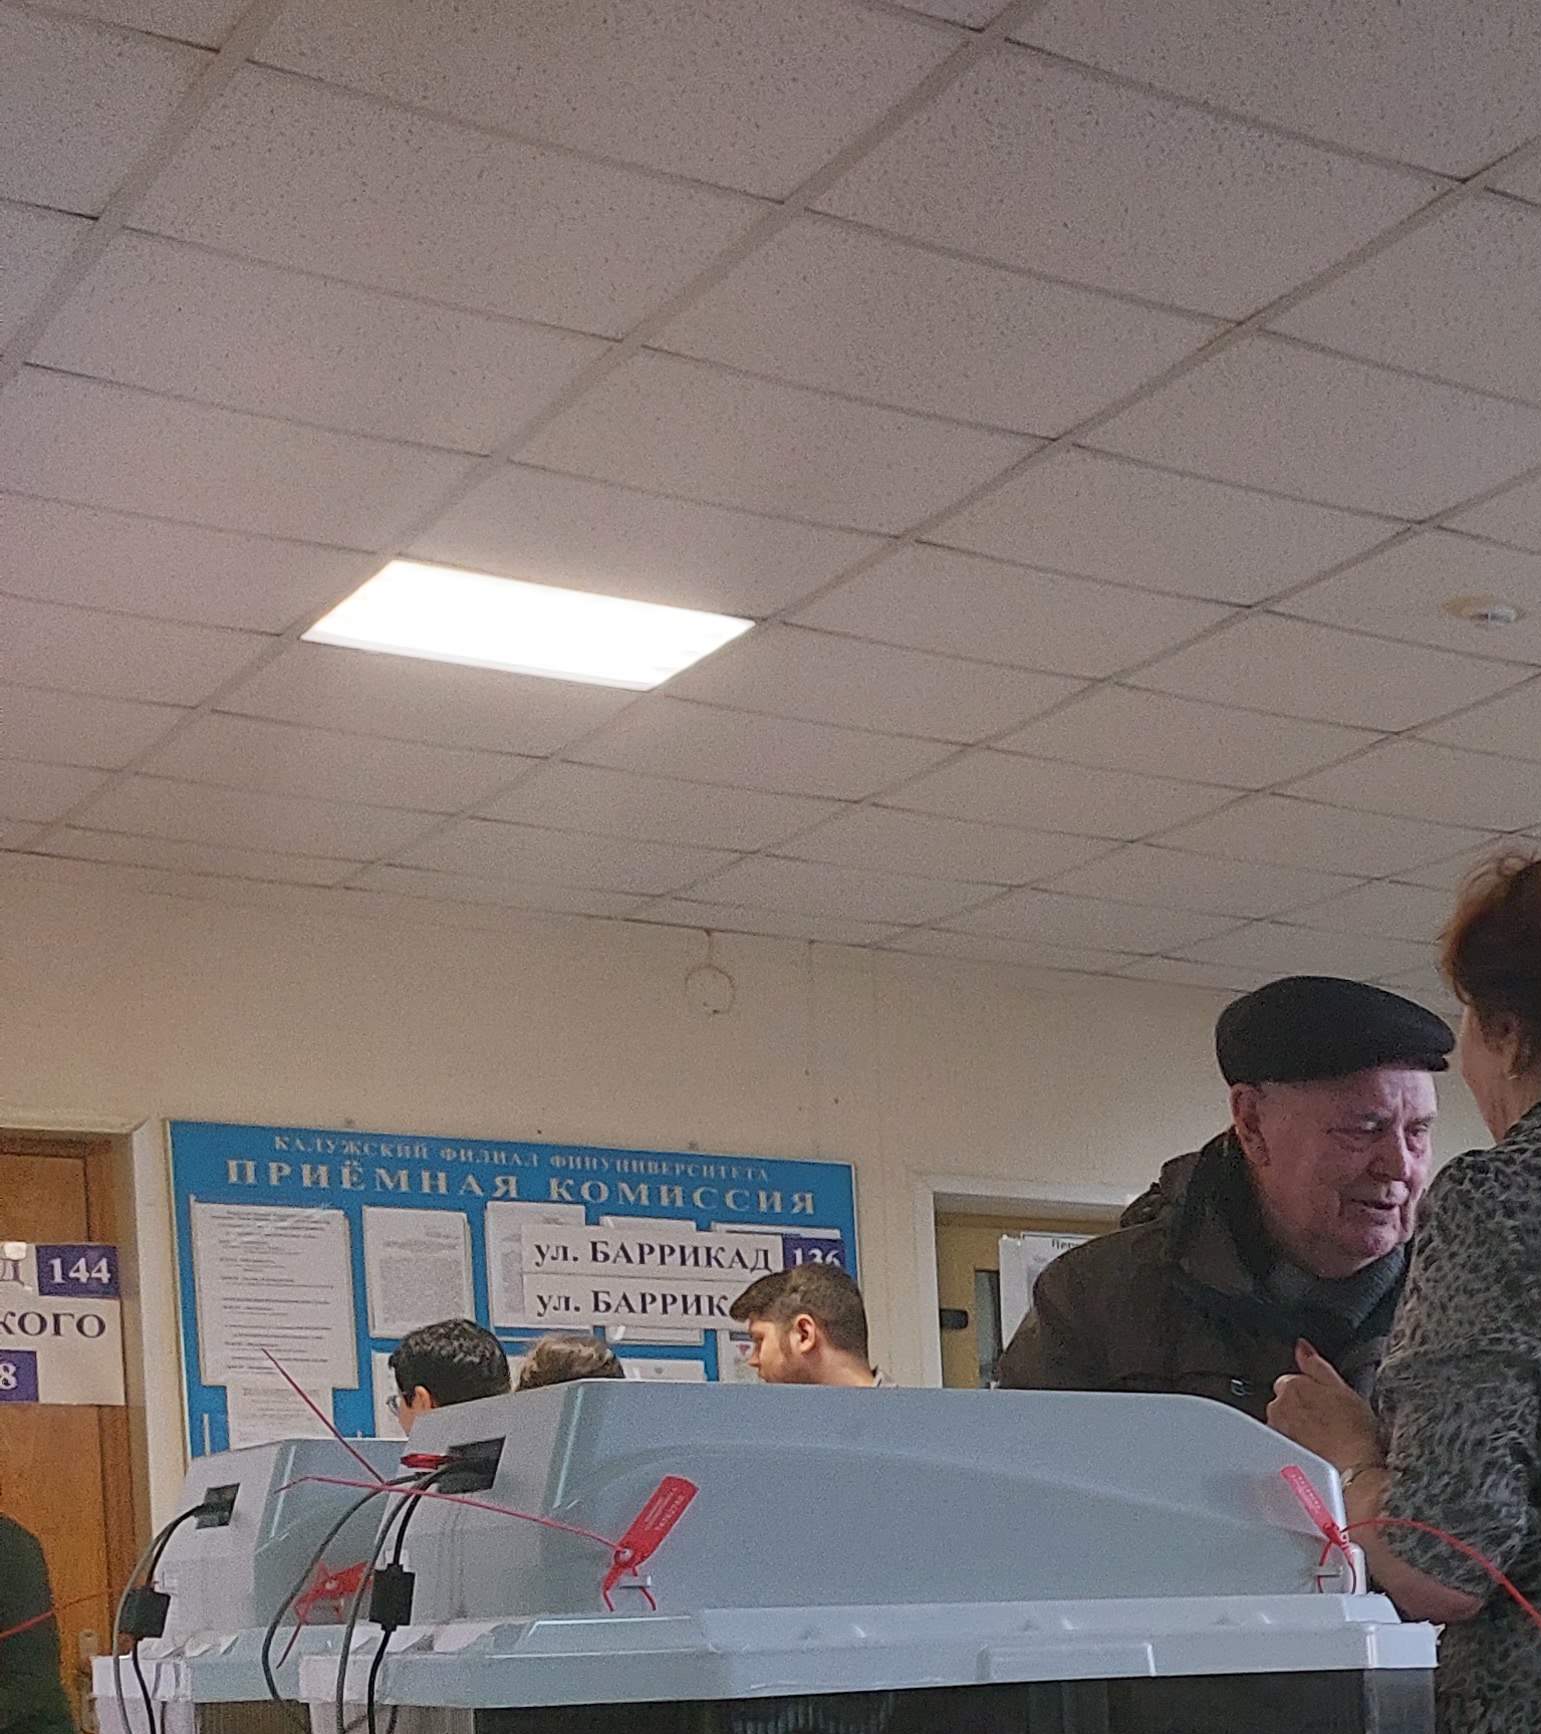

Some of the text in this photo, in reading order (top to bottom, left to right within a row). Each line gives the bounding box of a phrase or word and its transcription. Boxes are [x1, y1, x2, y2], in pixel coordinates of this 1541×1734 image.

[227, 1158, 815, 1215] ПРИЁМНАЯ КОМИССИЯ
[50, 1257, 111, 1284] 144
[534, 1243, 579, 1267] ул.
[589, 1240, 773, 1275] БАРРИКАД
[536, 1290, 730, 1318] ул. БАРРИК
